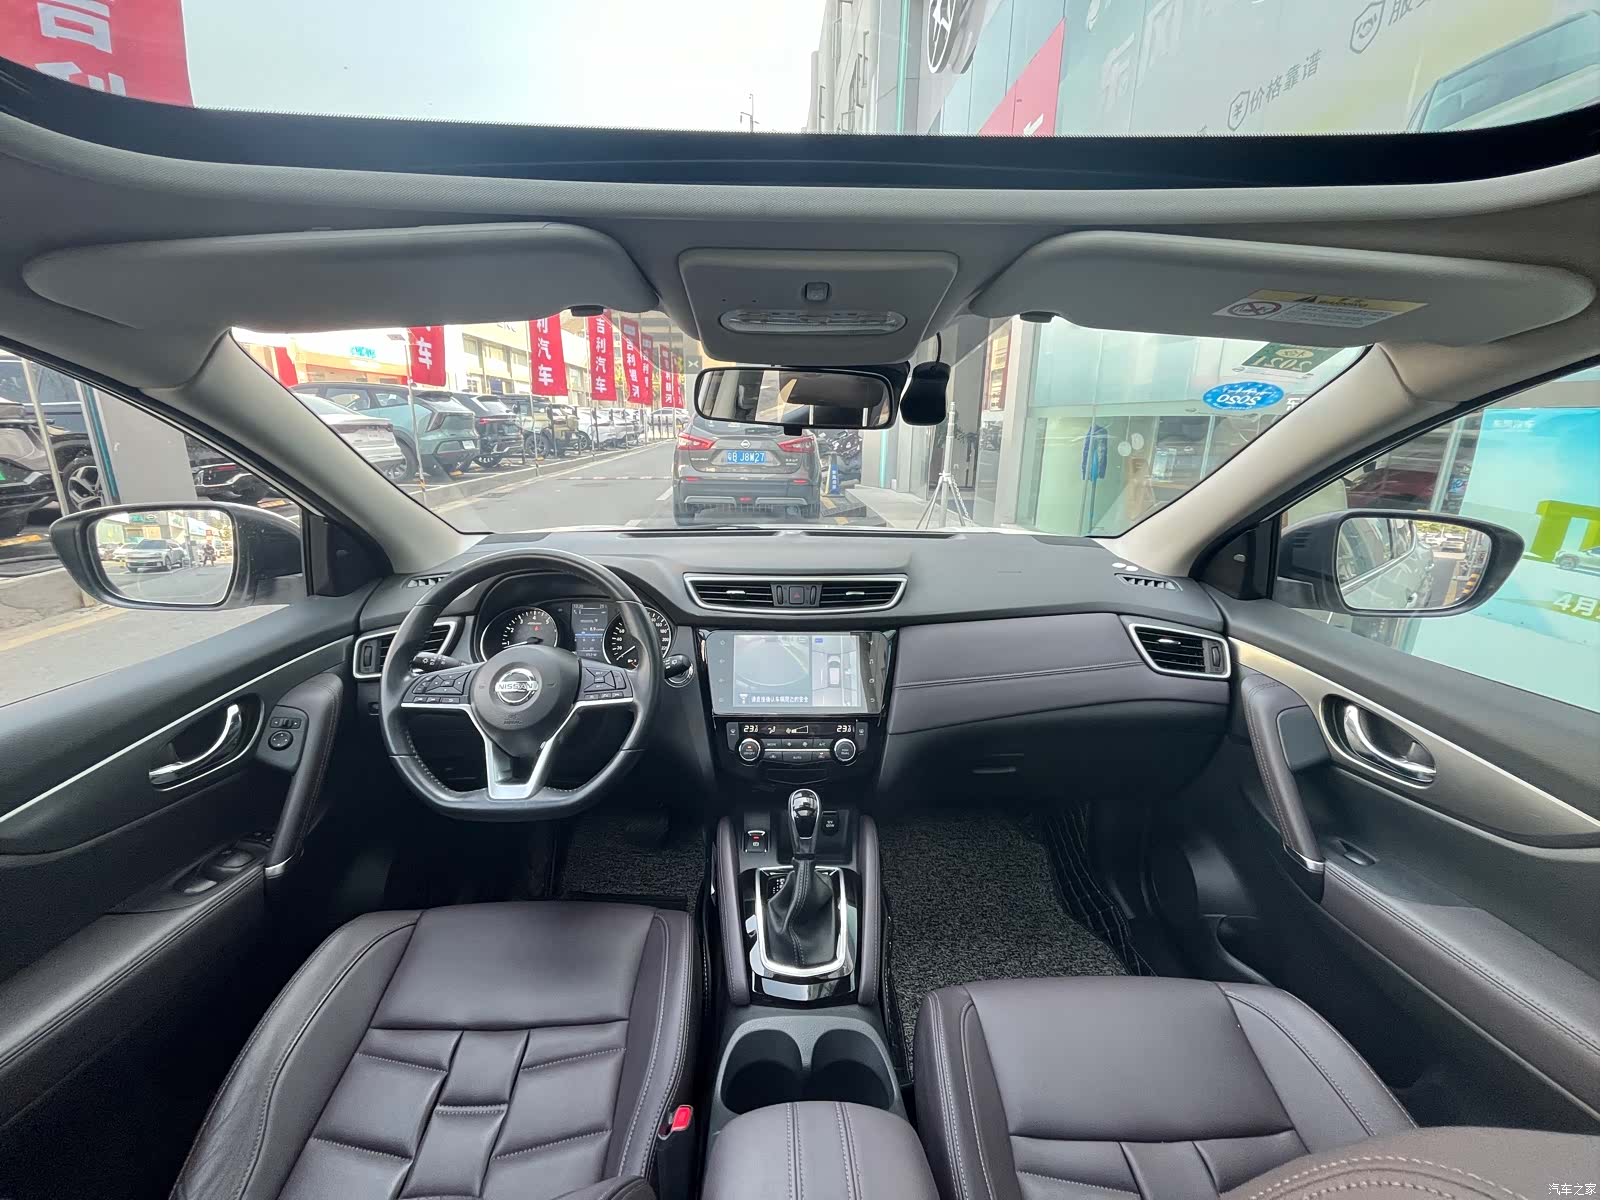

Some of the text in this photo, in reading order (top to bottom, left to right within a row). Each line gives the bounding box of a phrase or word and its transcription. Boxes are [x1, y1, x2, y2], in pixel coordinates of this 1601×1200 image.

[1250, 48, 1321, 114] 价格靠谱
[595, 317, 607, 393] 吉利汽车
[1553, 593, 1600, 619] 4月
